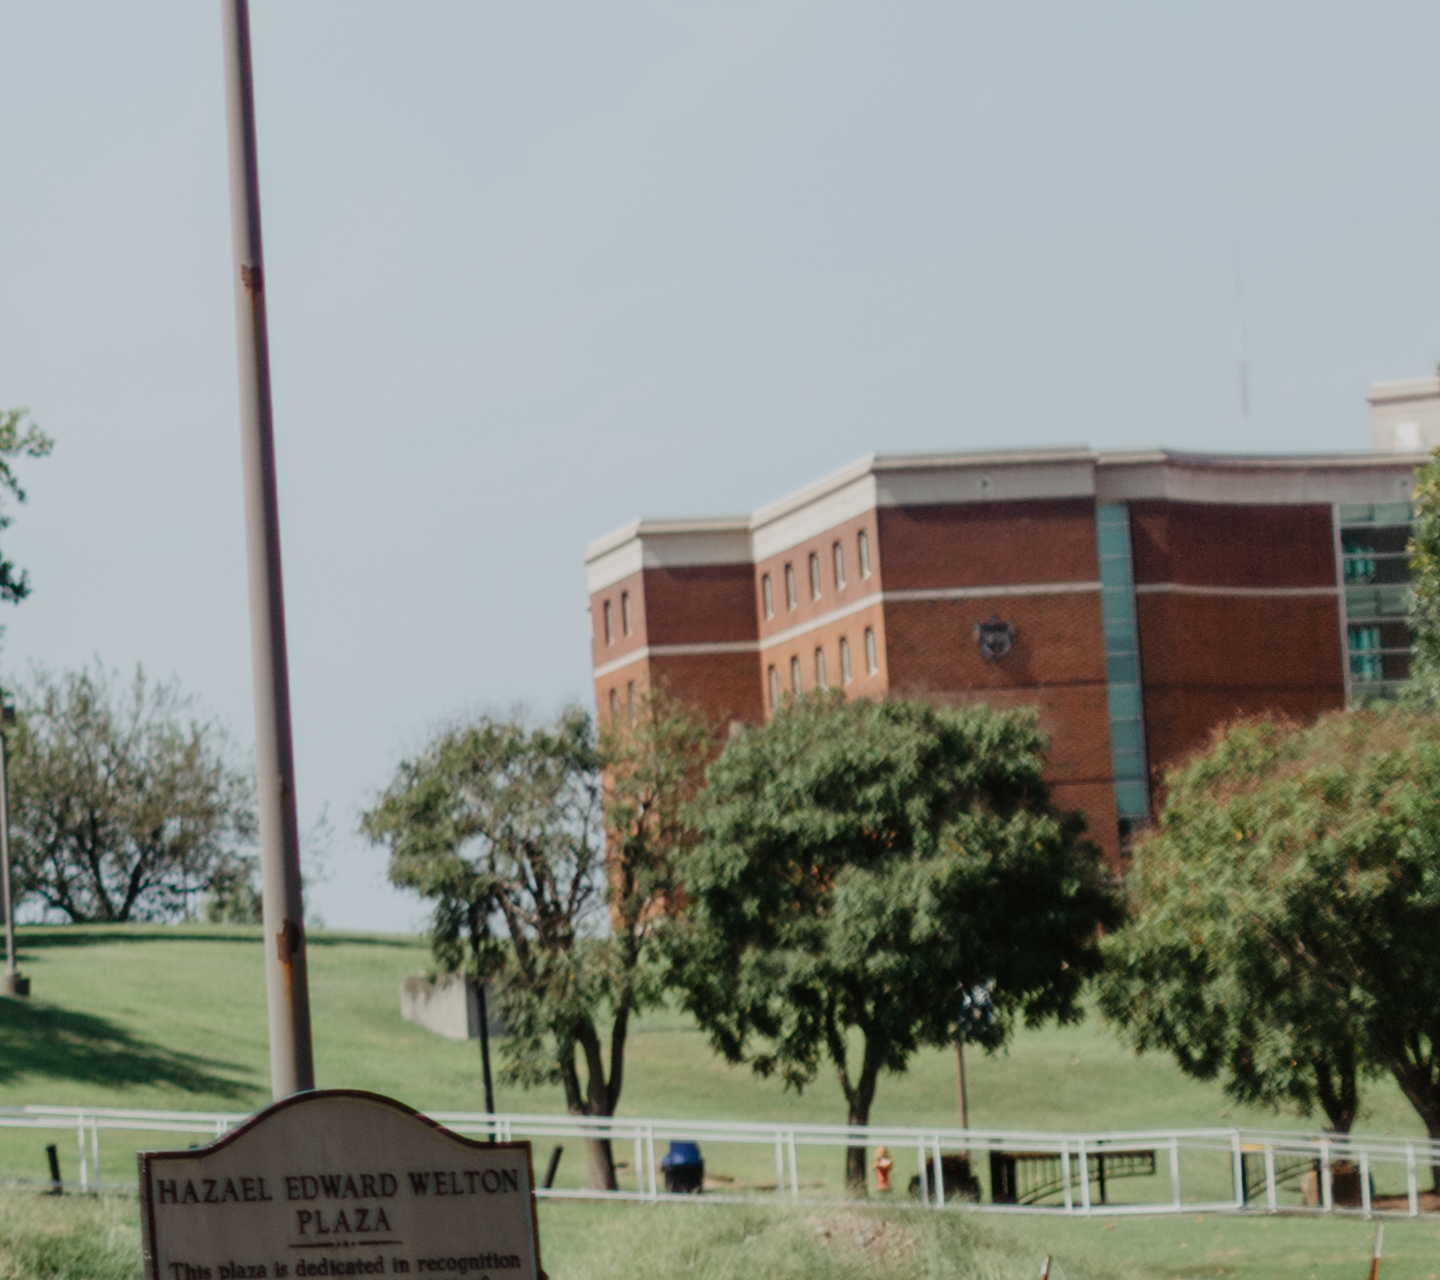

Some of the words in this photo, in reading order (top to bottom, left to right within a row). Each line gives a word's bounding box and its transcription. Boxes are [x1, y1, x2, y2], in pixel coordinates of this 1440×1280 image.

[157, 1176, 273, 1205] HAZAEL
[286, 1172, 398, 1201] EDWARD
[408, 1168, 520, 1196] WELTON
[297, 1206, 393, 1235] PLAZA
[274, 1259, 289, 1278] is
[295, 1255, 385, 1278] dedicated
[392, 1254, 410, 1274] in
[417, 1251, 521, 1275] recognition
